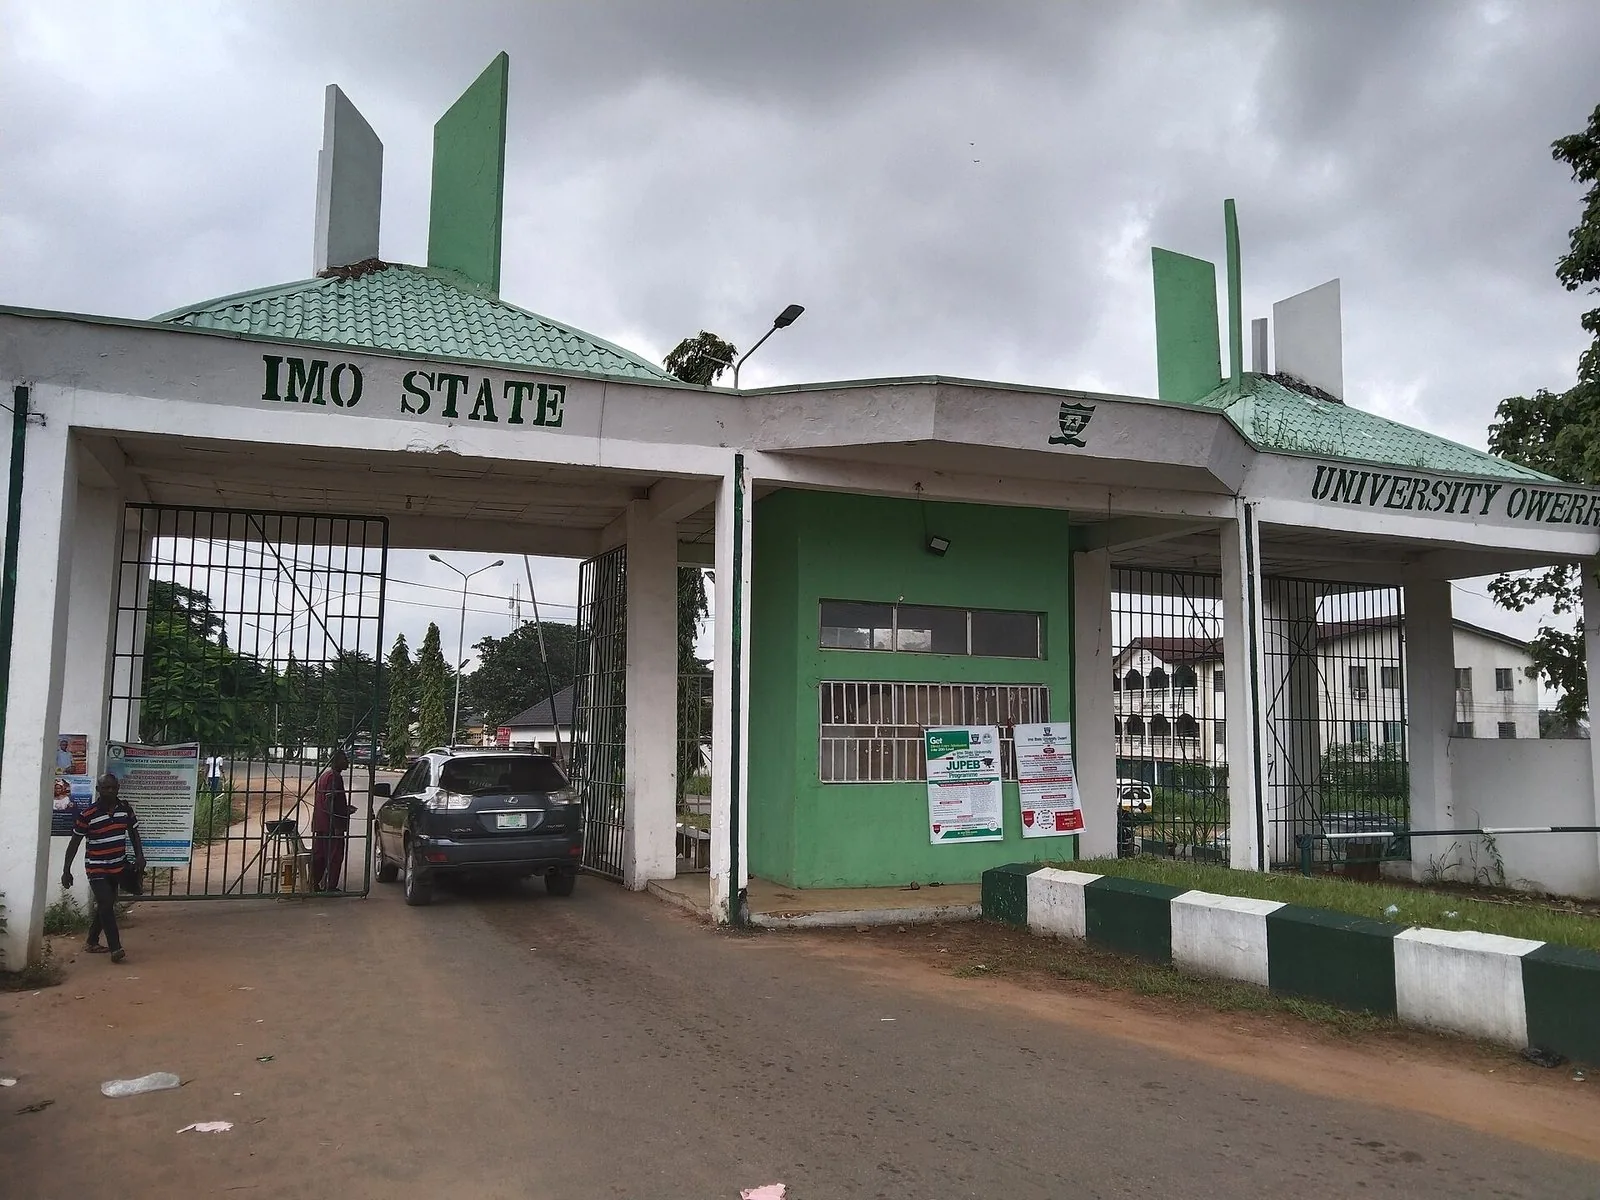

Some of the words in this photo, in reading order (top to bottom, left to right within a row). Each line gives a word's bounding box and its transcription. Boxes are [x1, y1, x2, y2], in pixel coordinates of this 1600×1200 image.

[261, 354, 364, 408] IMO
[401, 371, 567, 428] STATE
[1311, 465, 1502, 515] UNIVERSITY
[929, 736, 943, 745] Get
[946, 759, 981, 771] JUPEB
